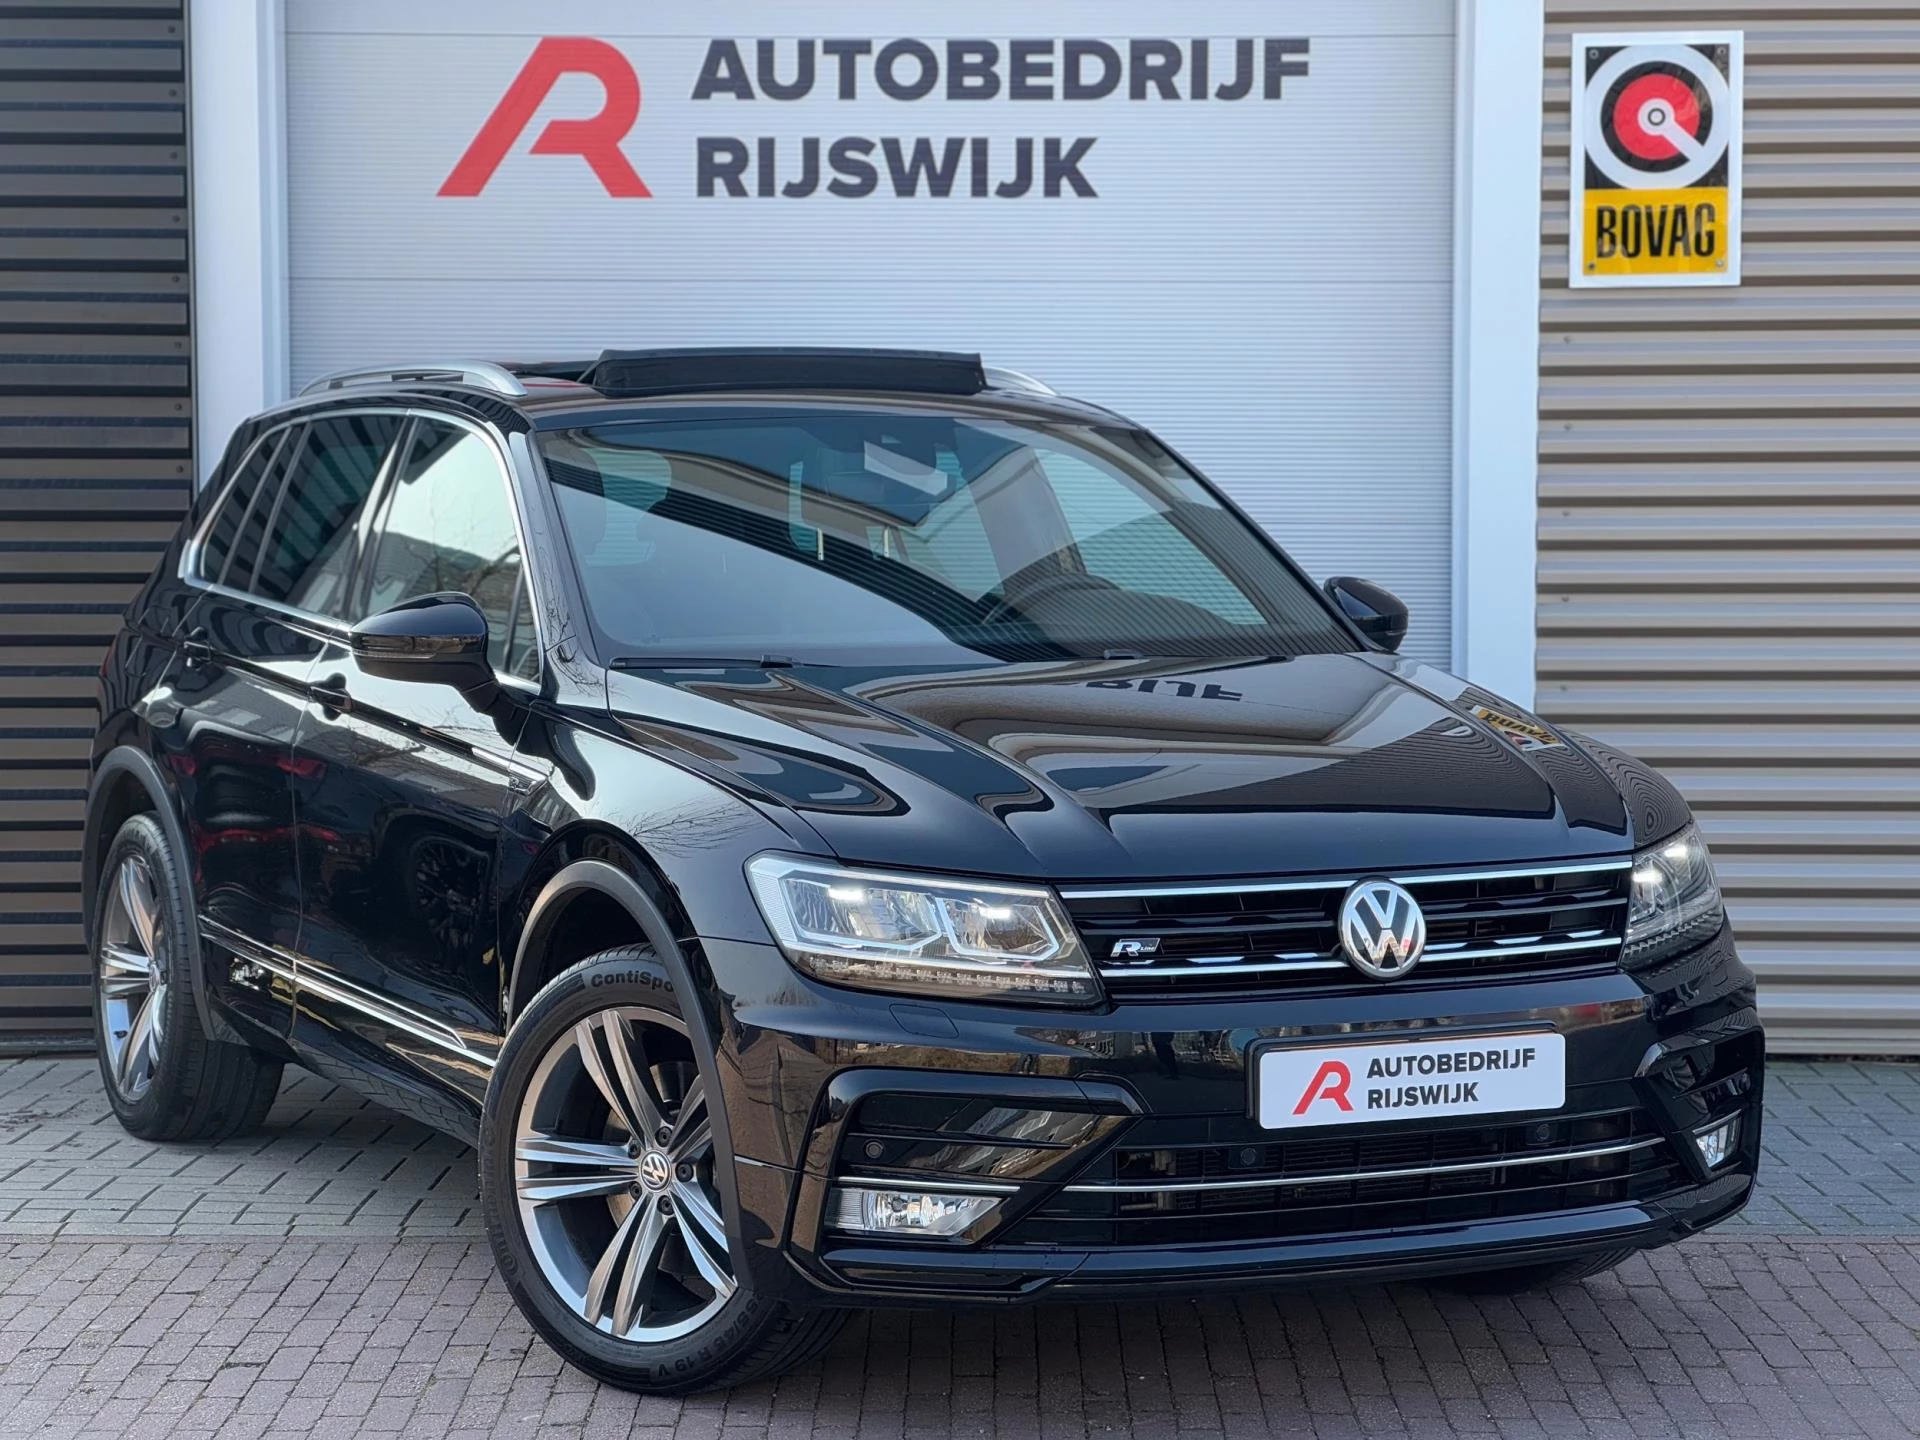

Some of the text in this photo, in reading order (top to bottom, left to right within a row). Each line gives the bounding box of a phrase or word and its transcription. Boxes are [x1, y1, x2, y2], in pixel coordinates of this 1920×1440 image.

[690, 37, 1311, 102] AUTOBEDRIJF
[697, 136, 1100, 200] RIJSWIJK
[1596, 203, 1716, 258] BOVAG
[1366, 1048, 1536, 1079] AUTOBEDRIJF
[1367, 1082, 1480, 1110] RIJSWIJK
